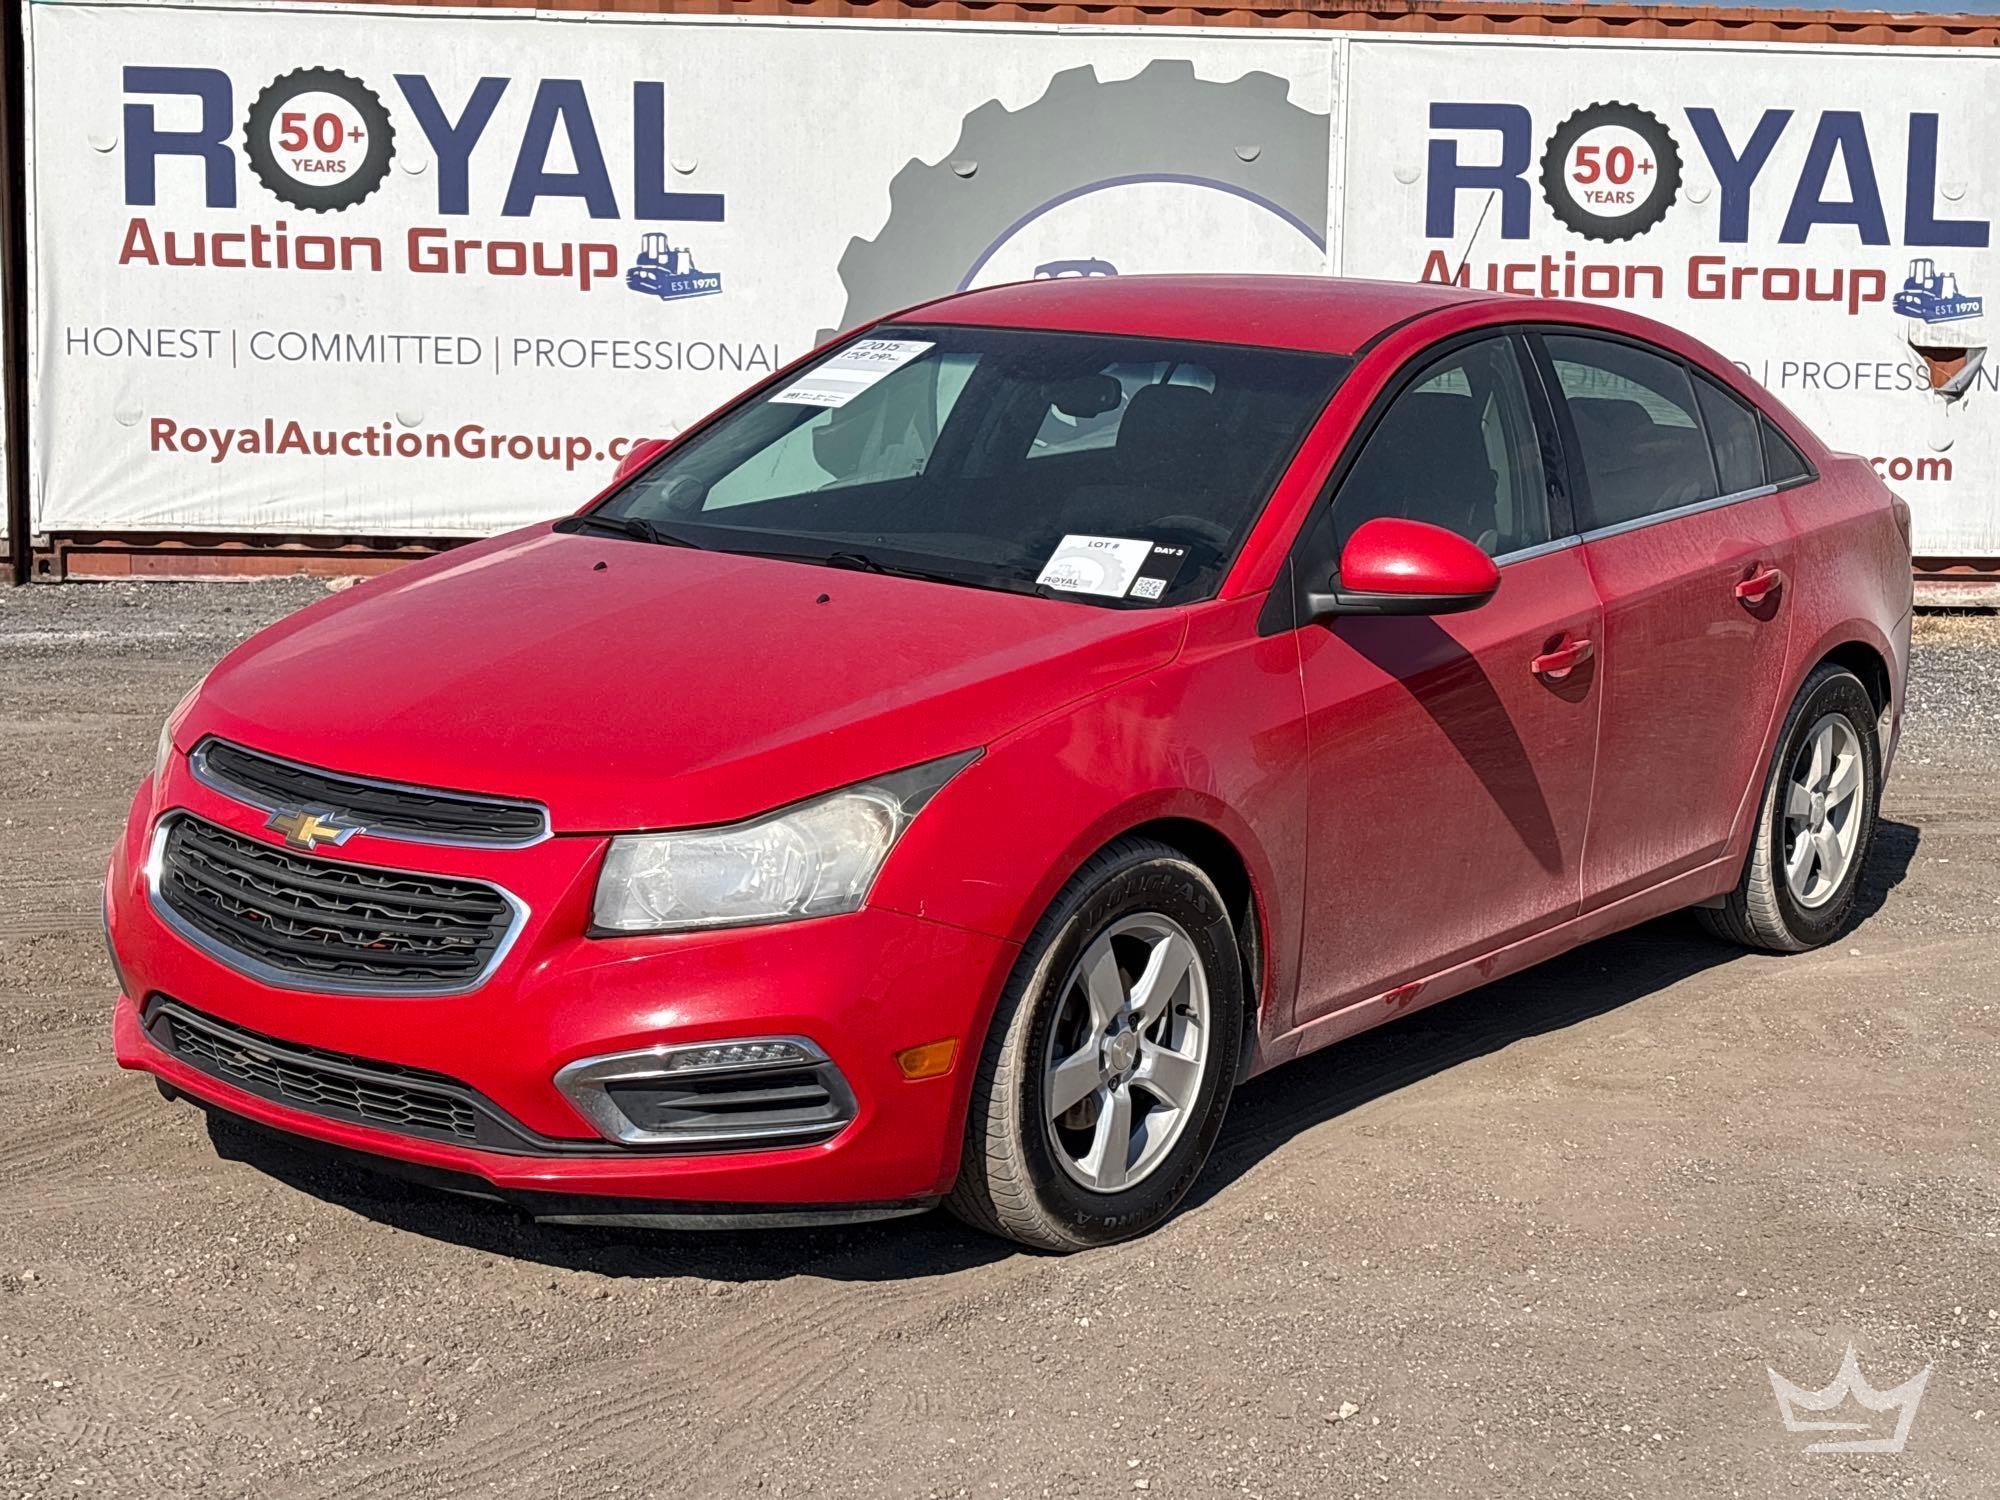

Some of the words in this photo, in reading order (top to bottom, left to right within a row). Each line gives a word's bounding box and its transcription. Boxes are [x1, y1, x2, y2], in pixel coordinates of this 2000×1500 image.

[123, 65, 724, 222] ROYAL
[279, 112, 365, 153] 50+
[291, 158, 347, 173] YEARS
[1426, 100, 1989, 247] ROYAL
[1572, 145, 1654, 185] 50+
[1583, 190, 1635, 204] YEARS
[119, 218, 381, 271] Auction
[408, 228, 617, 291] Group
[671, 281, 690, 291] EST.
[692, 278, 718, 289] 1970
[1421, 250, 1663, 299] Auction
[1688, 256, 1885, 314] Group
[1935, 304, 1953, 314] EST.
[1955, 302, 1980, 313] 1970
[66, 327, 221, 359] HONEST
[250, 331, 482, 366] COMMITTED
[513, 337, 781, 372] PROFESSIONAL
[1781, 361, 2000, 392] PROFESSN
[150, 418, 648, 471] RoyalAuctionGroup.c
[1087, 541, 1110, 549] LOT
[1154, 546, 1176, 555] DAY
